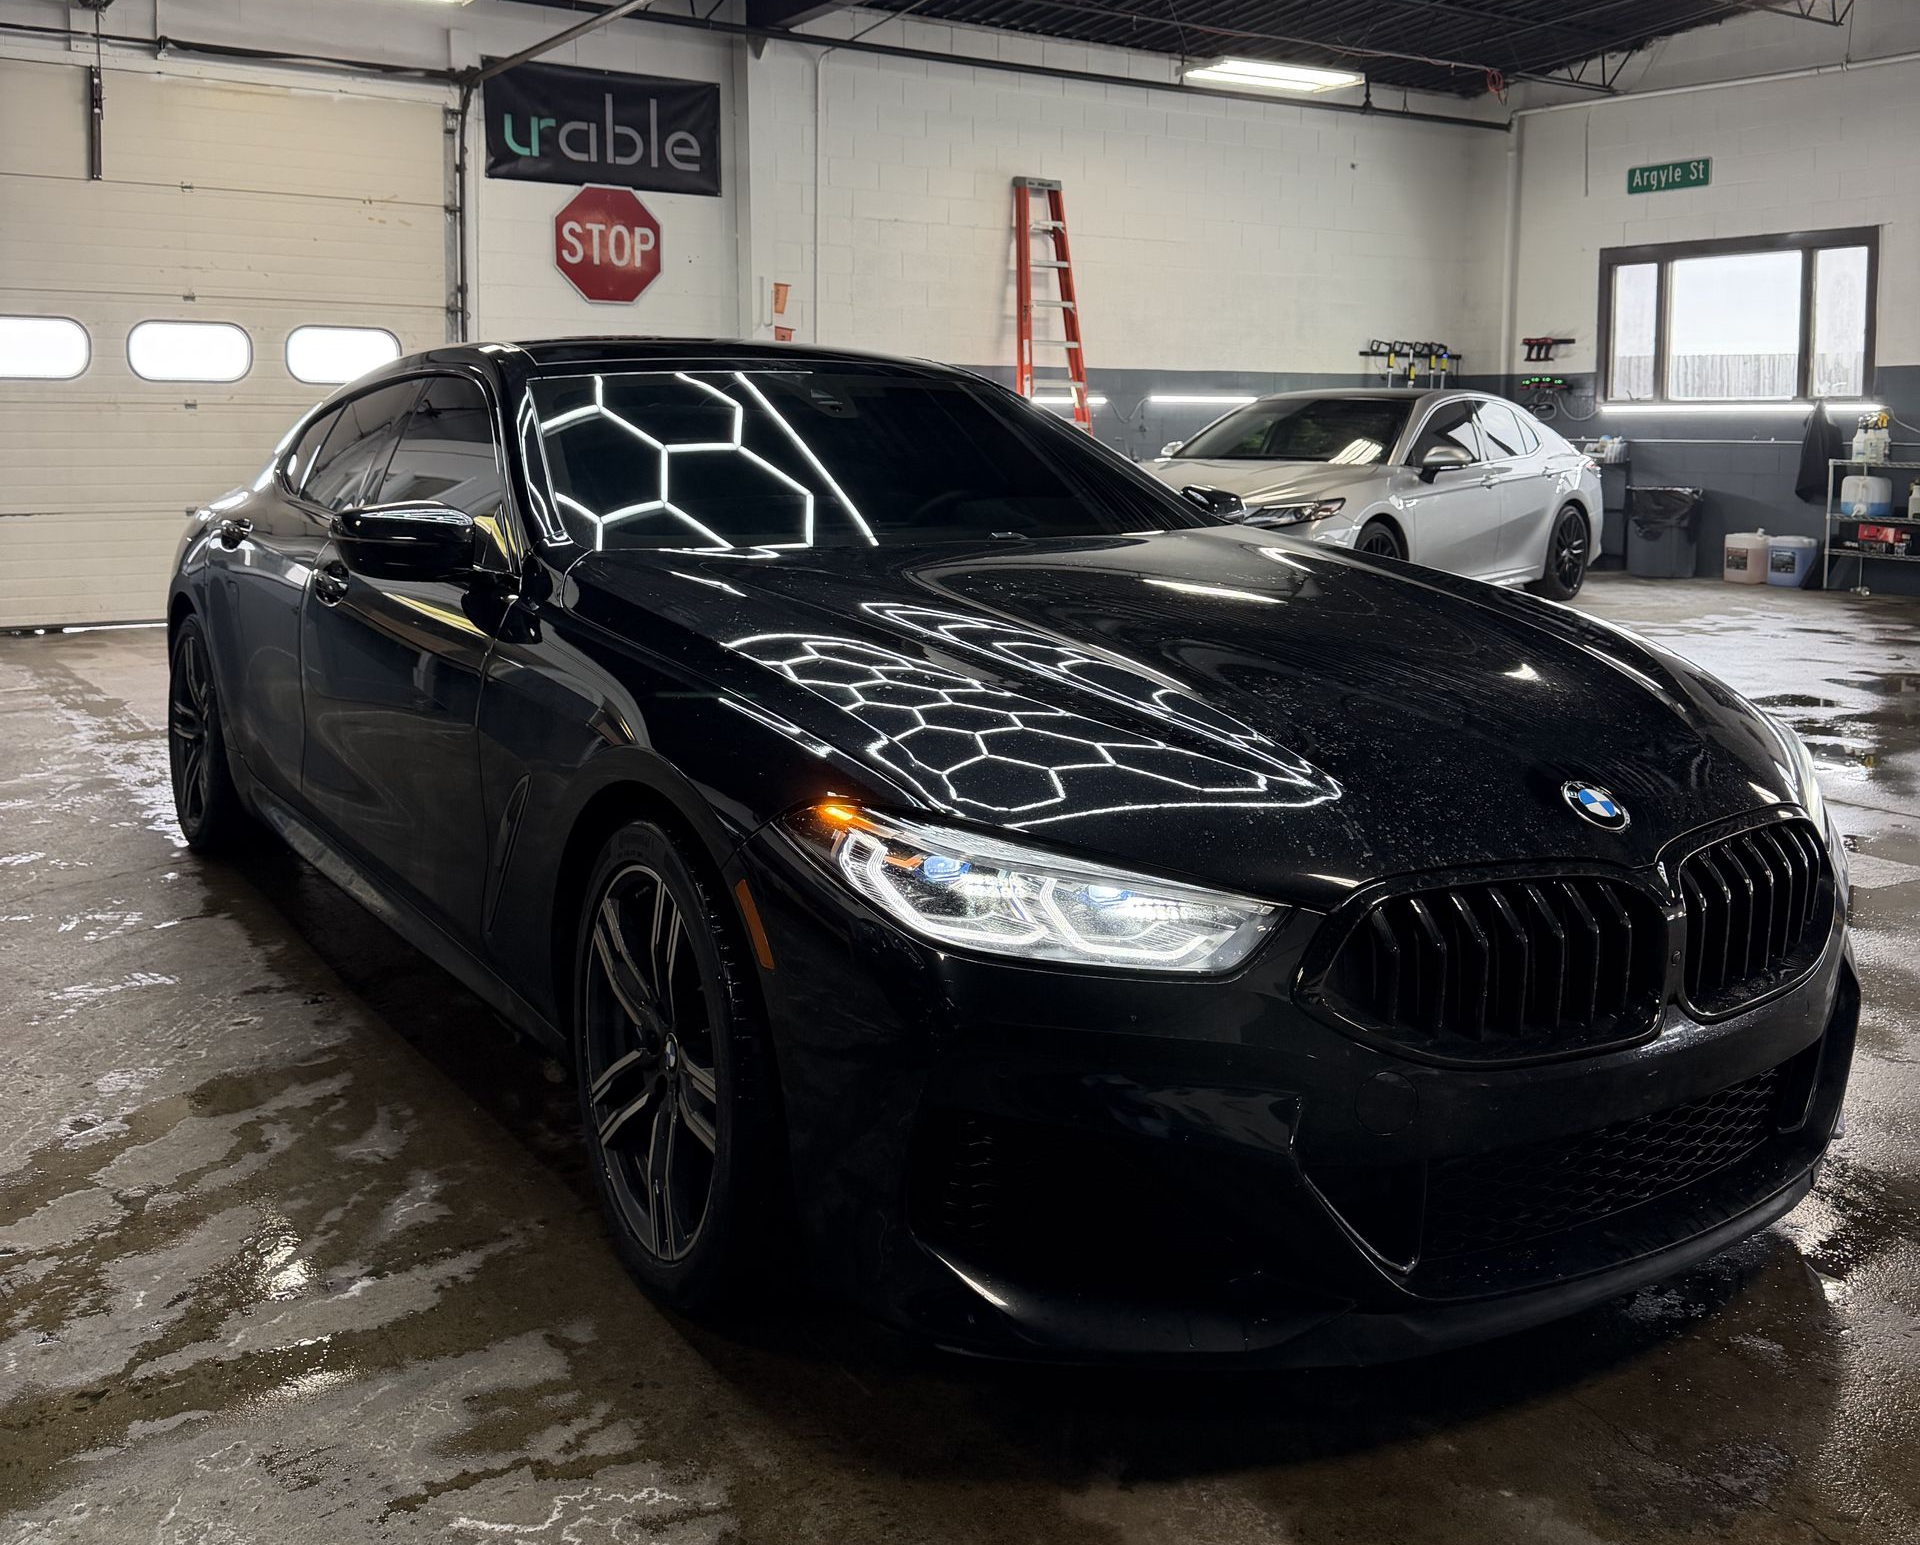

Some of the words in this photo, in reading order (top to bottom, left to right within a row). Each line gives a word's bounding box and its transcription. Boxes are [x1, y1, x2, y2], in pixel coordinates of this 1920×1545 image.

[503, 93, 700, 172] urable
[1632, 165, 1682, 190] Argyle
[1689, 161, 1705, 180] St
[561, 221, 655, 268] STOP
